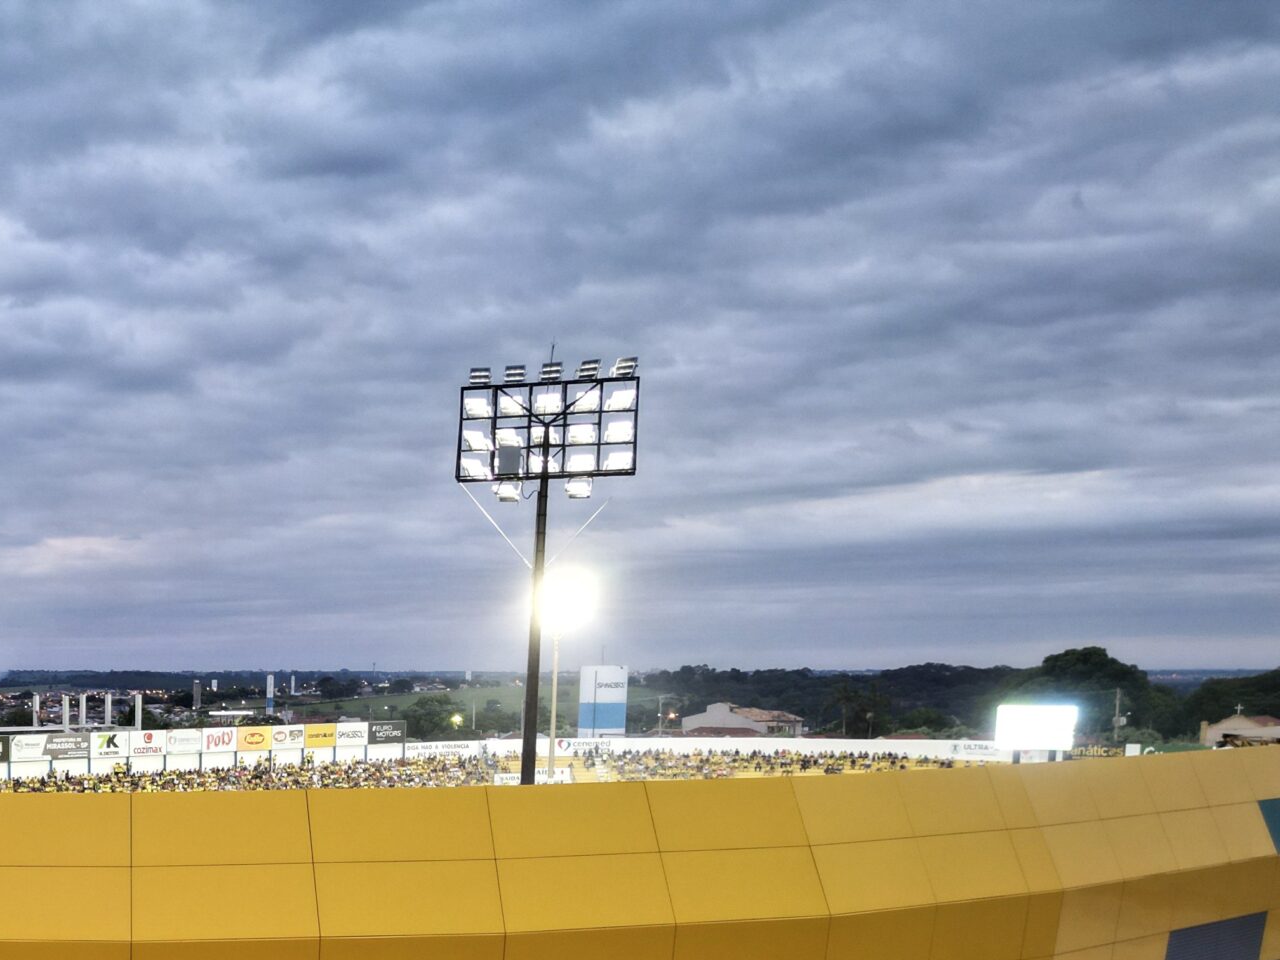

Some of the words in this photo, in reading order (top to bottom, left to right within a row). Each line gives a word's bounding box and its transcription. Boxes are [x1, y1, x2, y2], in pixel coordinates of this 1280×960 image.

[376, 724, 393, 732] EURO
[96, 733, 119, 749] 7K
[133, 746, 163, 755] cozimax
